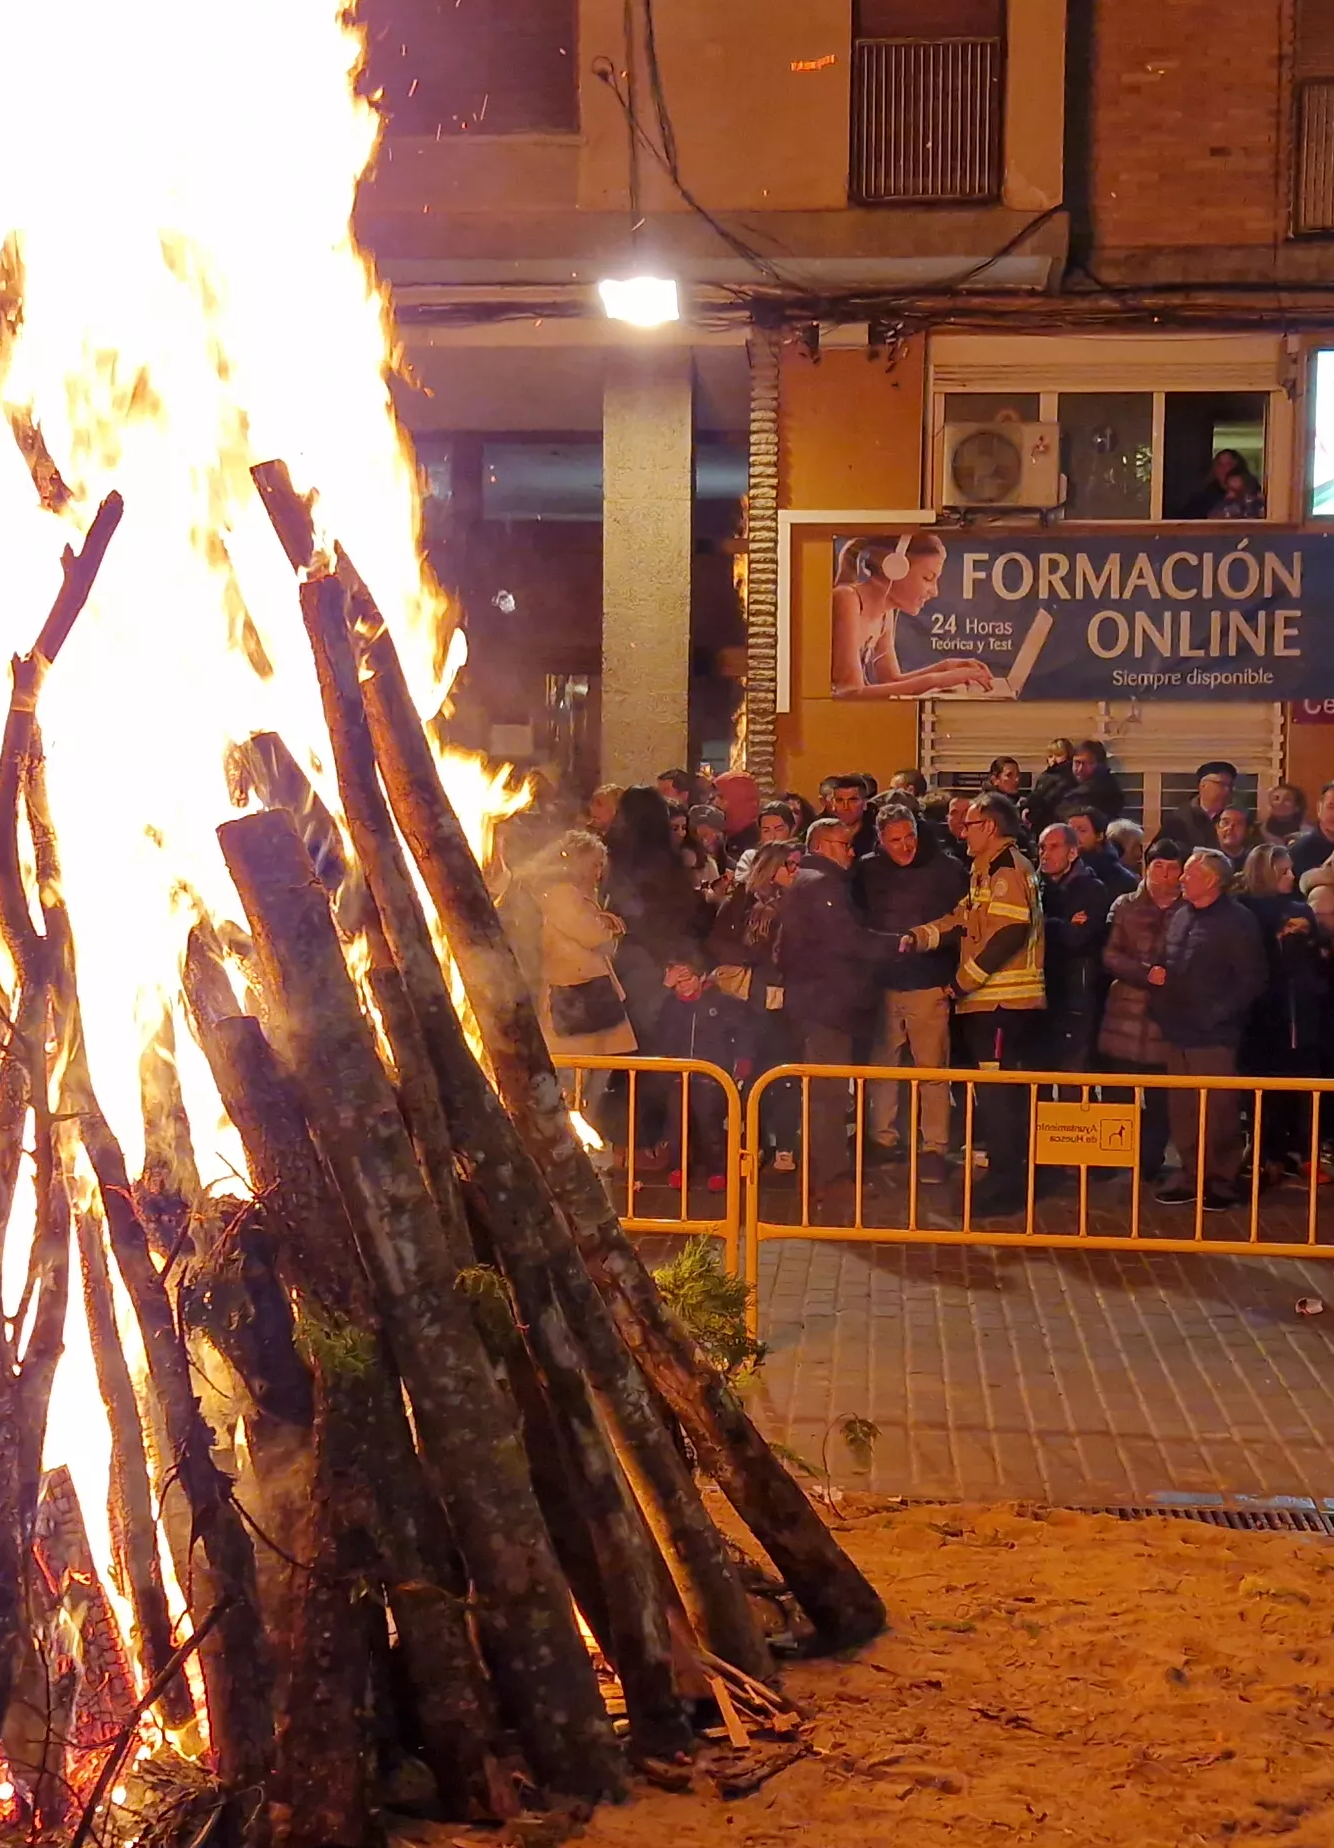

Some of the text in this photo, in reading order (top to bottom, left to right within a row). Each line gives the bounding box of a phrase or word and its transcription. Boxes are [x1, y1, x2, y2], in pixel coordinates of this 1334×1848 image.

[961, 537, 1302, 600] FORMACIÓN
[931, 613, 1013, 635] 24 Horas
[1087, 610, 1302, 658] ONLINE
[931, 637, 1013, 654] Teórica y Test
[1112, 668, 1274, 690] Siempre disponible
